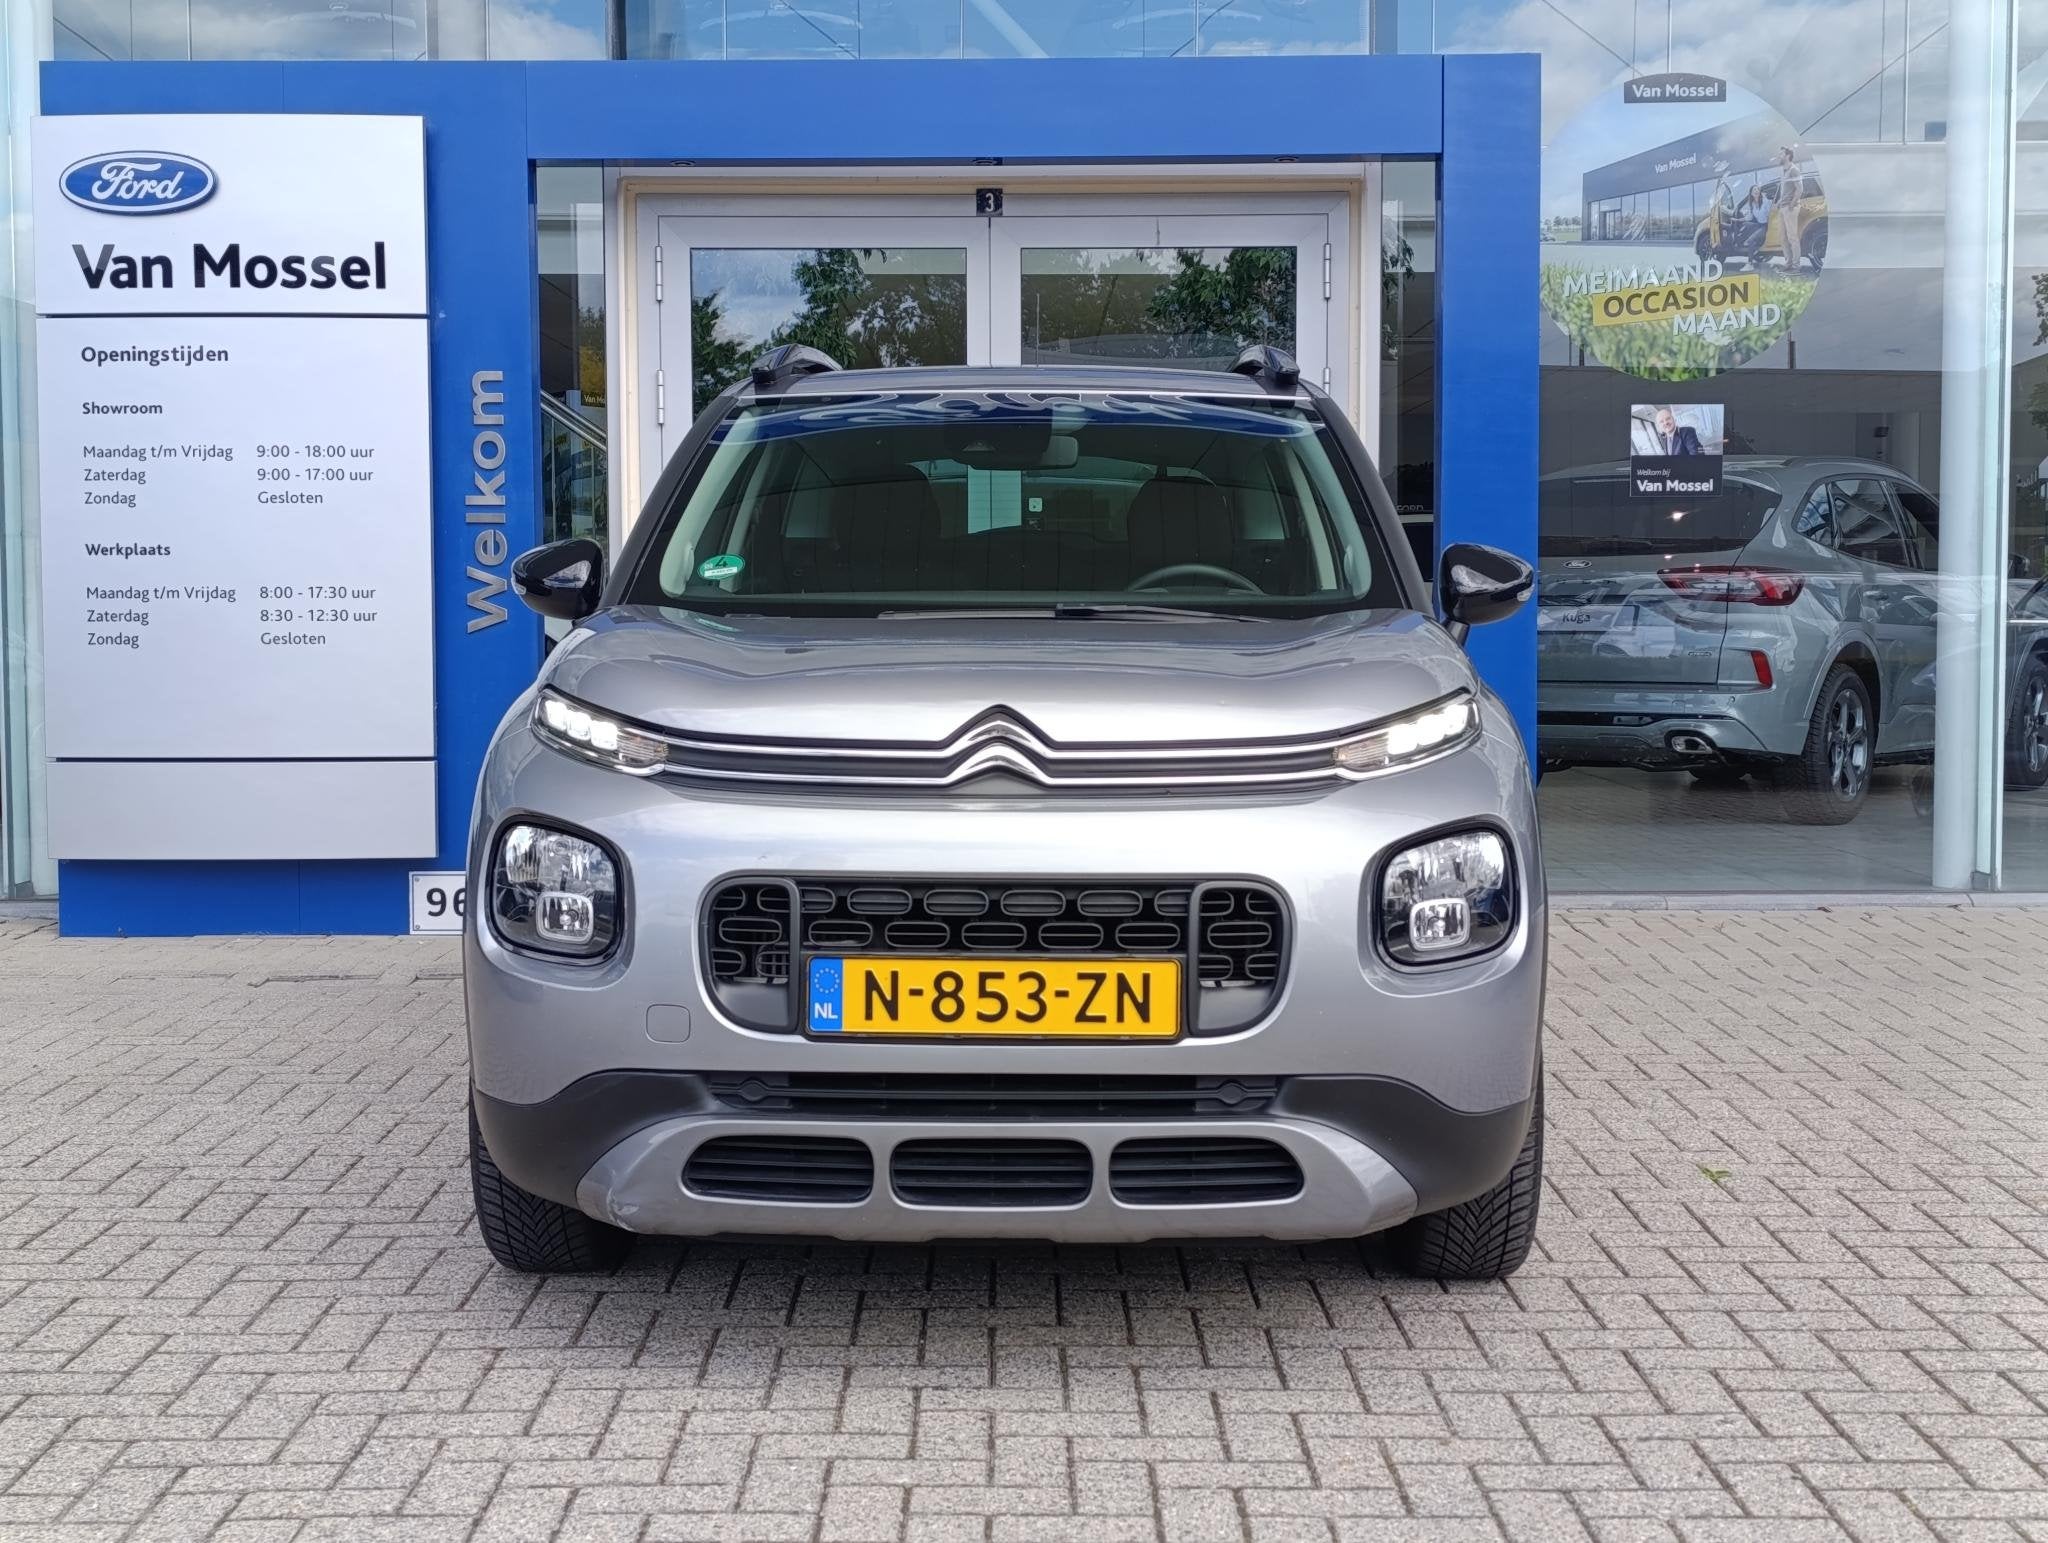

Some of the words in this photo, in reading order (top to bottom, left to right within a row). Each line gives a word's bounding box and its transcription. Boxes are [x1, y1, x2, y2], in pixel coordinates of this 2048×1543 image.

[1632, 84, 1660, 97] Van
[1665, 82, 1718, 97] Mossel
[91, 161, 184, 200] Ford
[985, 192, 994, 211] 3
[72, 243, 173, 290] Van
[193, 241, 386, 290] Mossel
[1564, 259, 1723, 297] MEIMAAND
[1603, 281, 1749, 318] OCCASION
[1673, 303, 1781, 336] MAAND
[81, 345, 229, 367] Openingstijden
[82, 401, 163, 415] Showroom
[83, 444, 147, 464] Maandag
[150, 444, 177, 460] t/m
[181, 444, 233, 464] Vrijdag
[256, 445, 290, 459] 9:00
[304, 445, 346, 459] 18:00
[350, 448, 375, 459] uur
[83, 467, 147, 486] Zaterdag
[257, 467, 291, 481] 9:00
[305, 467, 346, 481] 17:00
[349, 471, 374, 481] uur
[1637, 480, 1662, 491] Van
[1666, 479, 1714, 492] Mossel
[84, 490, 137, 508] Zondag
[257, 490, 324, 505] Gesloten
[465, 370, 508, 634] Welkom
[85, 542, 172, 560] Werkplaats
[86, 585, 150, 605] Maandag
[153, 585, 180, 601] t/m
[184, 585, 237, 605] Vrijdag
[259, 585, 294, 600] 8:00
[308, 585, 347, 600] 17:30
[351, 588, 377, 600] uur
[87, 608, 150, 628] Zaterdag
[260, 608, 294, 623] 8:30
[308, 608, 350, 623] 12:30
[353, 612, 378, 623] uur
[1562, 611, 1591, 624] Kuga
[87, 631, 140, 650] Zondag
[260, 631, 326, 646] Gesloten
[864, 969, 1151, 1024] N-853-ZN
[814, 1003, 838, 1020] NL
